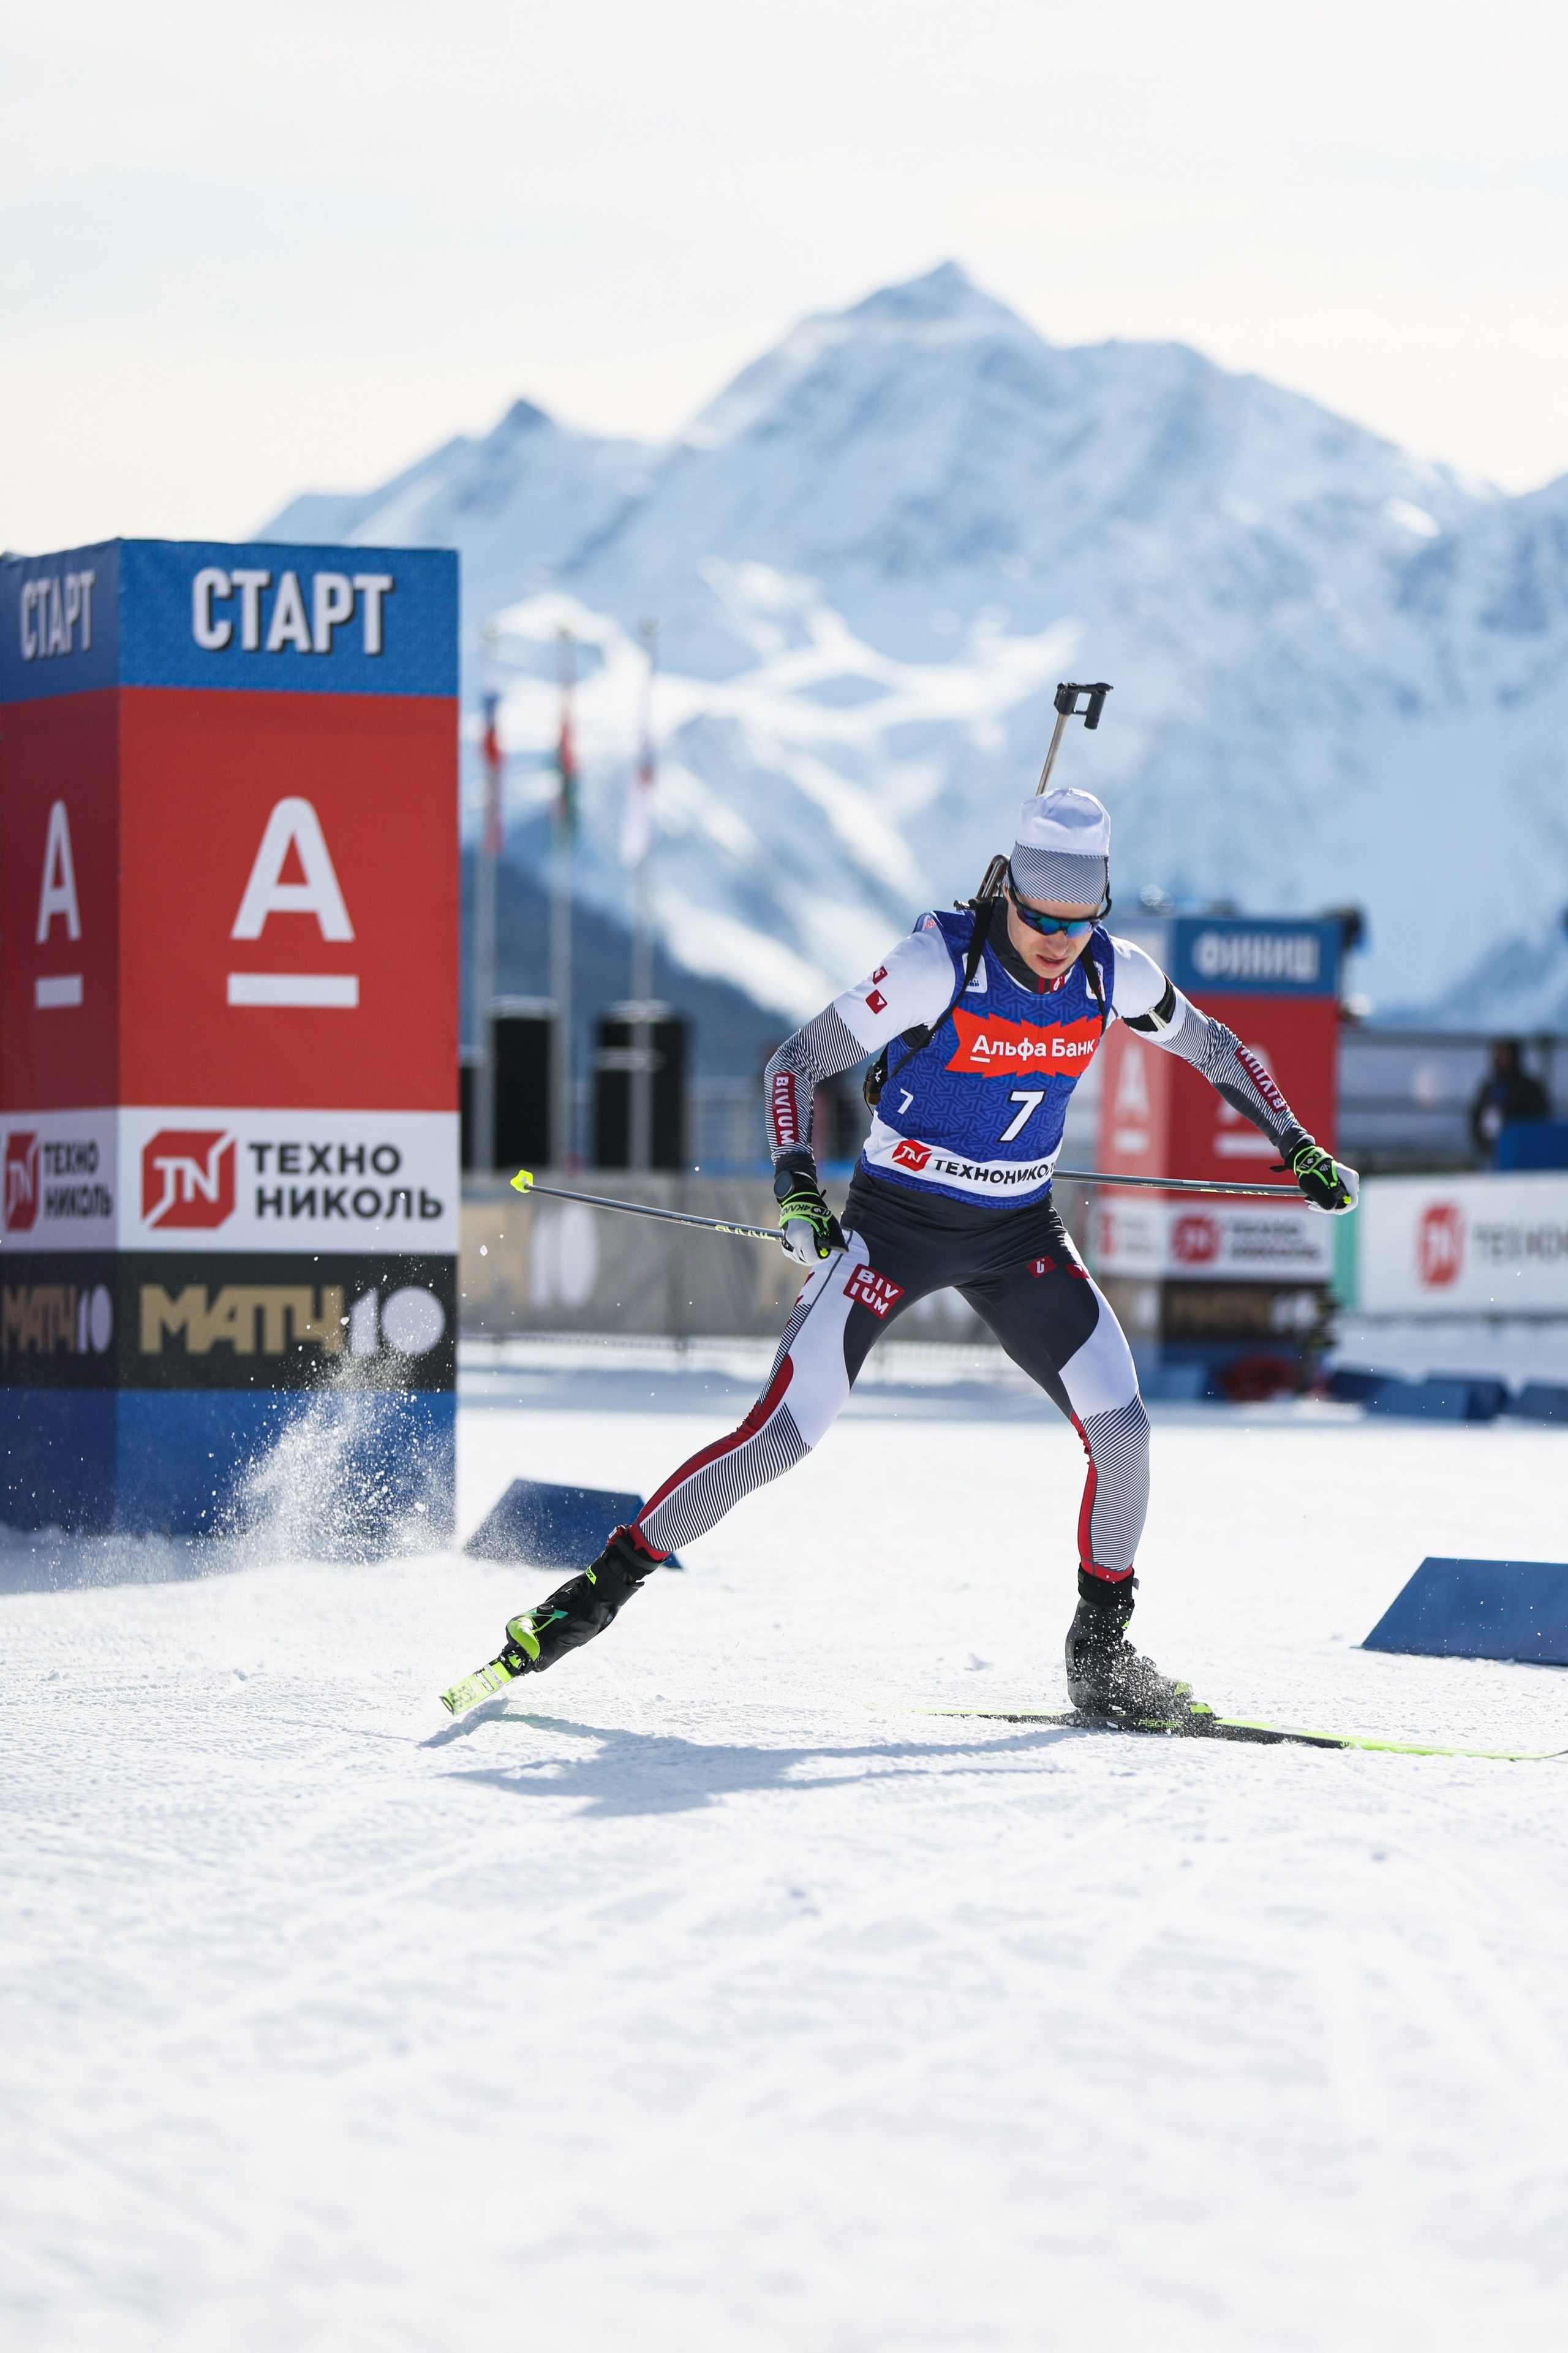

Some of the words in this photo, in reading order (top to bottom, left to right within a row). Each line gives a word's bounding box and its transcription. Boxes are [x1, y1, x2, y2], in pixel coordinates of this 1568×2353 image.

[20, 570, 96, 662] СТАРТ
[192, 567, 394, 655] СТАРТ
[970, 1034, 1047, 1063] Альфа
[1051, 1038, 1096, 1058] Банк
[897, 1087, 914, 1115] 7
[1240, 1048, 1286, 1109] BIVIUM
[774, 1076, 795, 1146] BIVIUM
[997, 1089, 1047, 1143] 7
[43, 1139, 100, 1177] ТЕХНО
[248, 1141, 401, 1176] ТЕХНО
[255, 1187, 444, 1220] НИКОЛЬ
